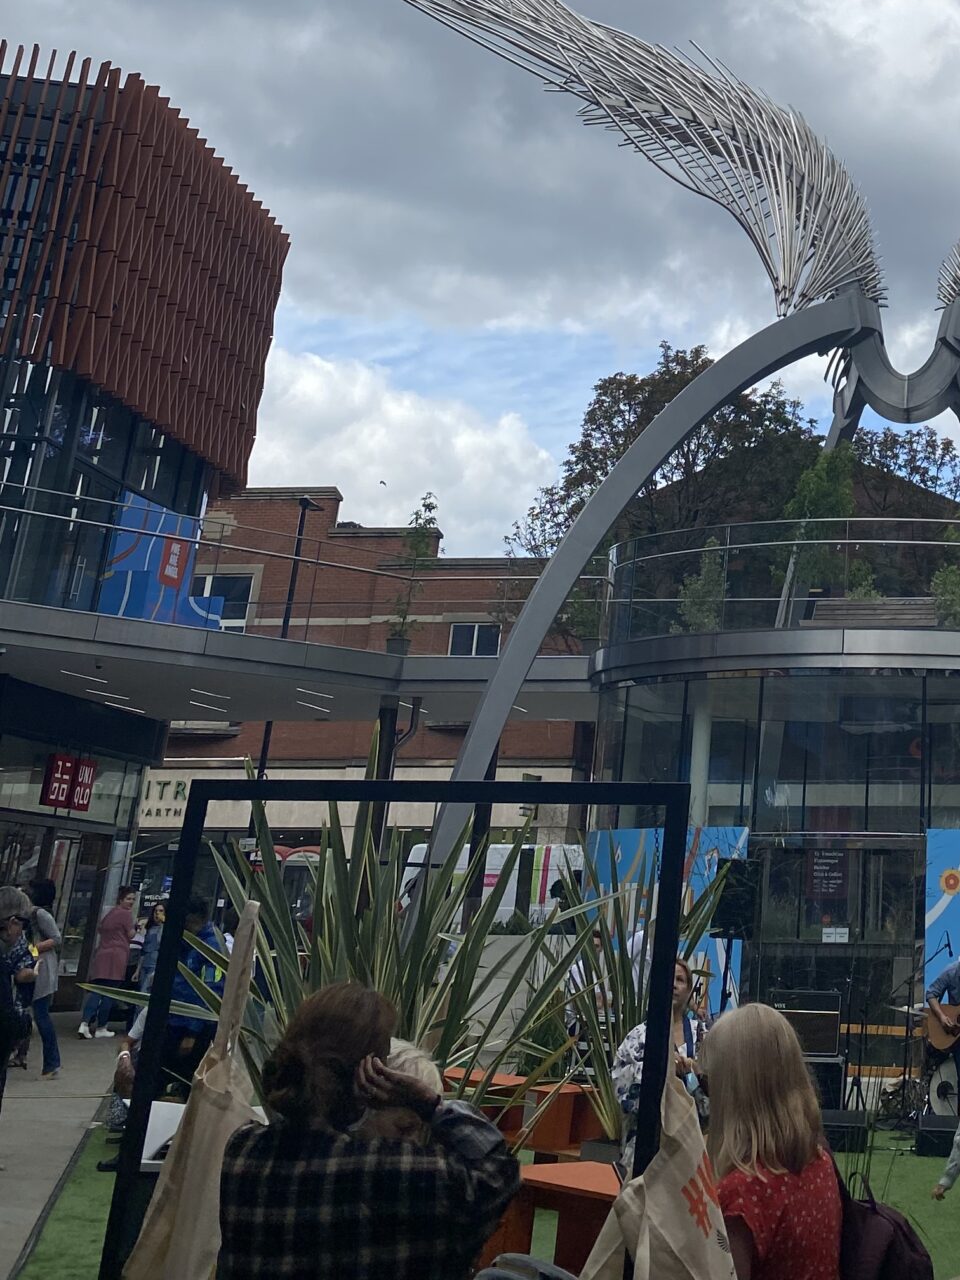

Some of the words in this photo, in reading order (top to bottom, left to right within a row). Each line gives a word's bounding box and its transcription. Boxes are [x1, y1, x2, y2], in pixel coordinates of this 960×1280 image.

[78, 765, 94, 784] UNI
[73, 786, 90, 806] QLO
[144, 780, 186, 801] ITR
[142, 808, 182, 817] ARTN
